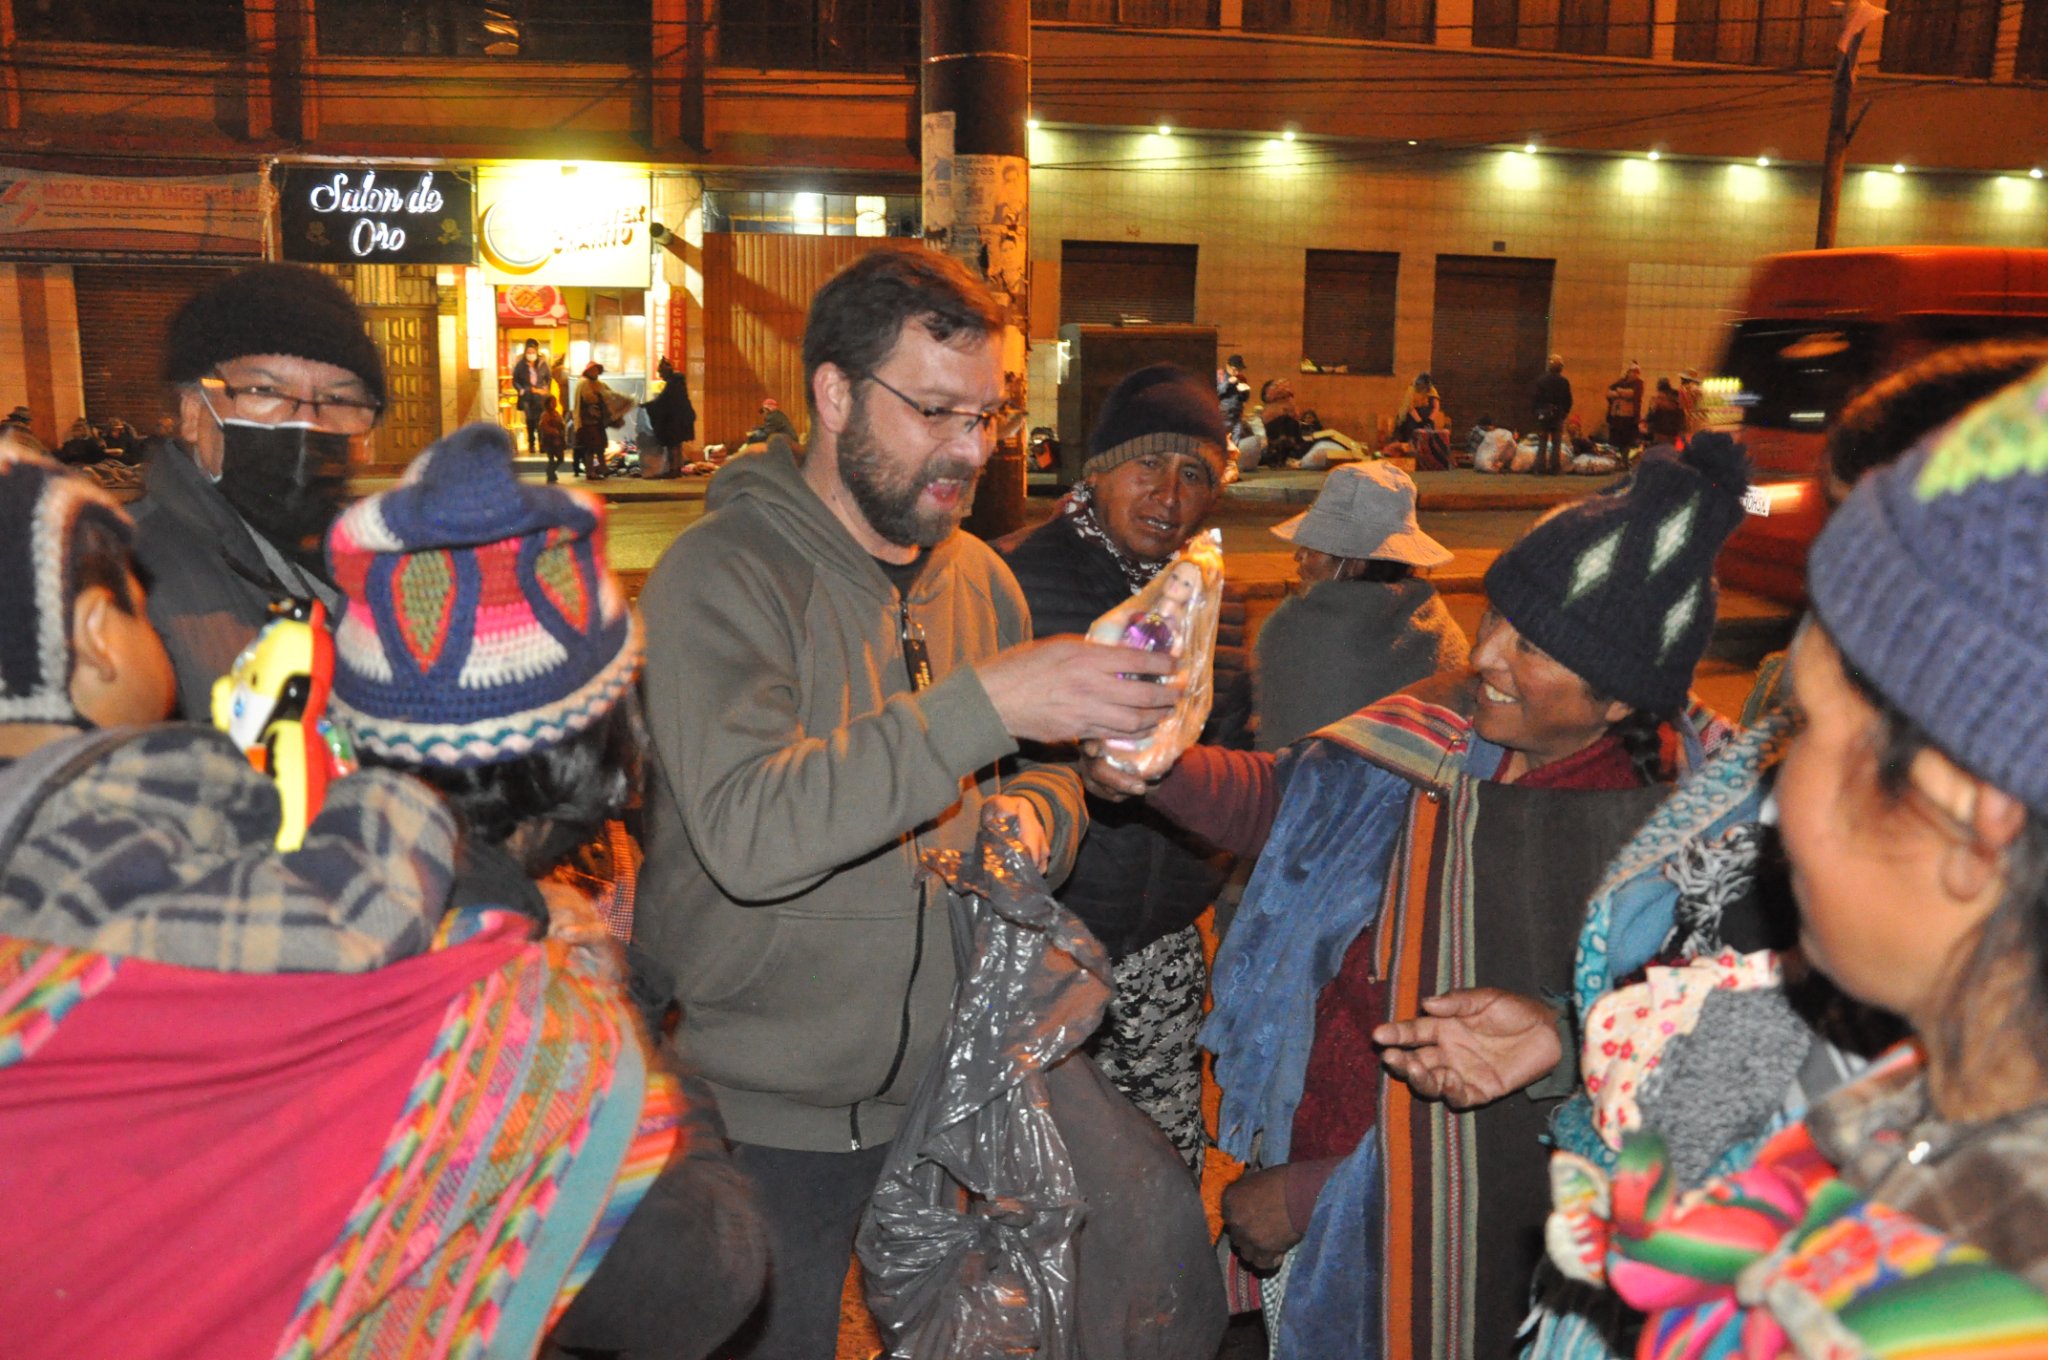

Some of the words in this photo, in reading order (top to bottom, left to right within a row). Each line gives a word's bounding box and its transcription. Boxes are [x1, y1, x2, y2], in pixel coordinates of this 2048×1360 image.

[90, 184, 153, 202] SUPPLY
[310, 170, 403, 213] Salon
[406, 170, 444, 213] de
[350, 217, 406, 256] Oro
